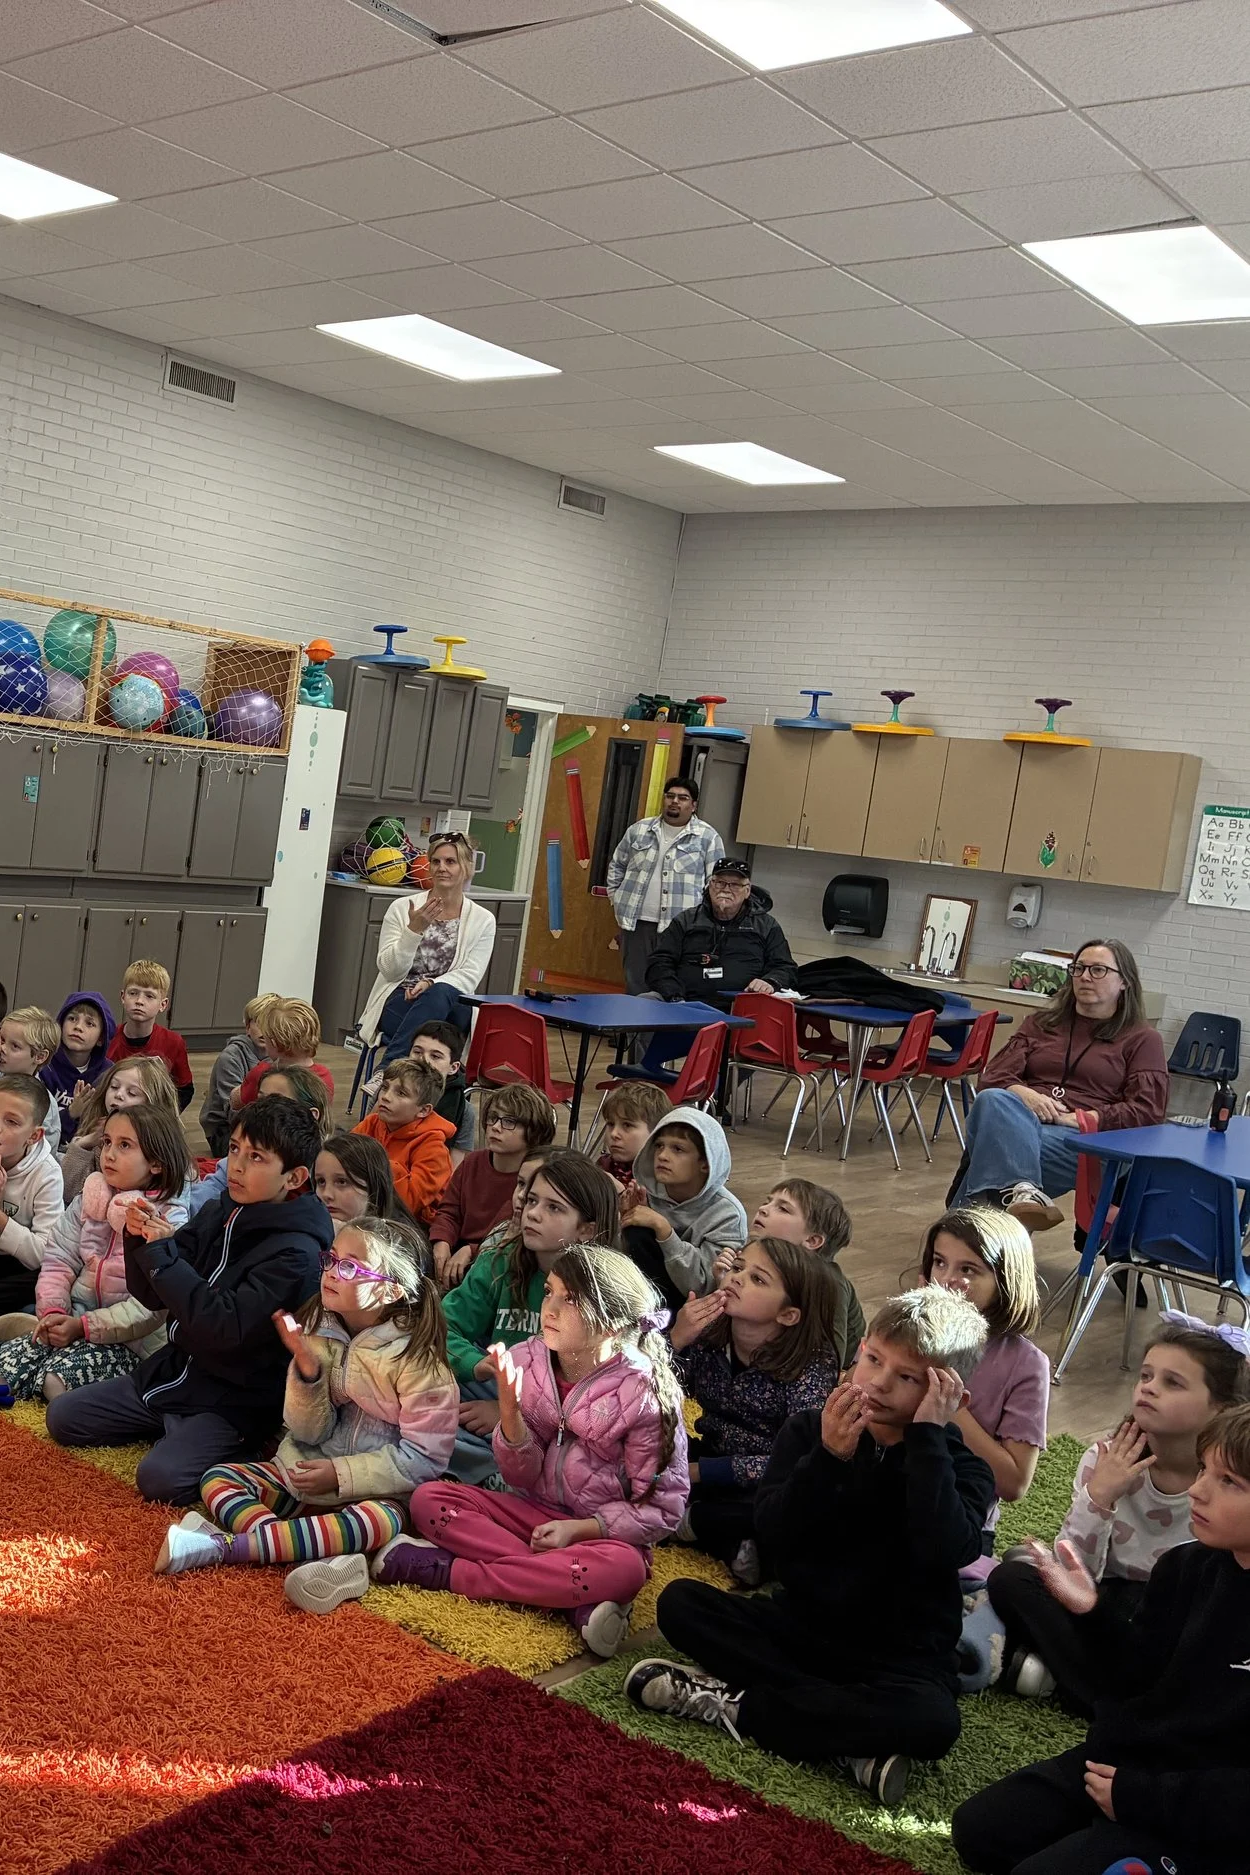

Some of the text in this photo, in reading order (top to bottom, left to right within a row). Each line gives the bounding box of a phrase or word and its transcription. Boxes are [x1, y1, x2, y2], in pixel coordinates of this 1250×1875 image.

[1207, 817, 1244, 829] Aa Bb
[1207, 829, 1221, 840] Ee
[1228, 831, 1243, 841] Ff
[1224, 844, 1237, 857] Jj
[1200, 853, 1219, 863] Mm
[1222, 855, 1238, 866] Nn
[1221, 867, 1236, 877] Rr
[1201, 877, 1239, 890] Uu Vv
[1198, 889, 1237, 906] Xx Yy
